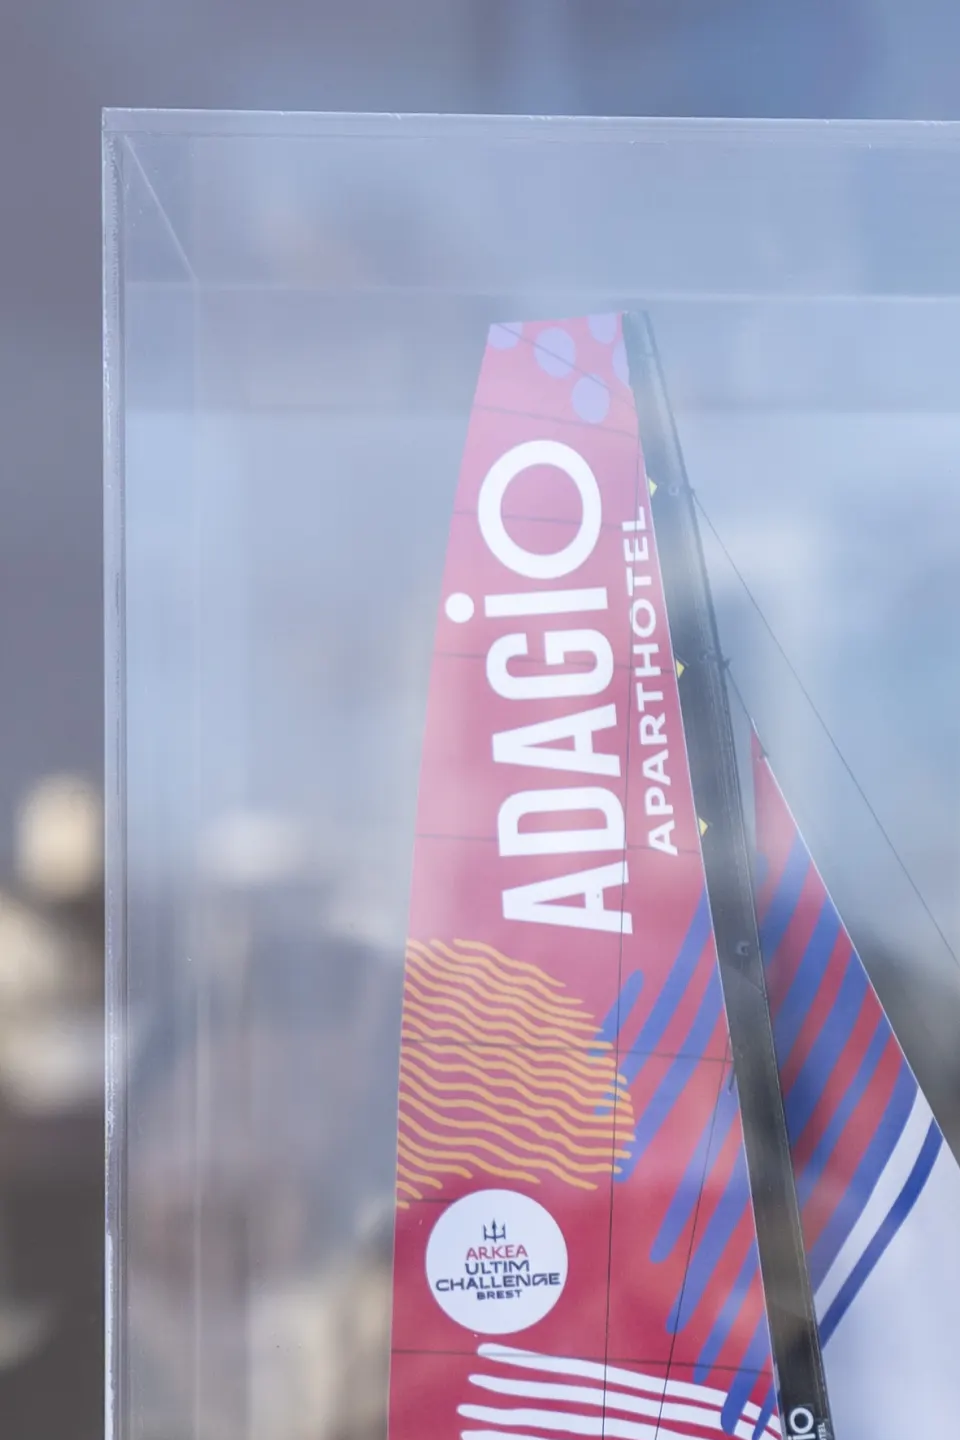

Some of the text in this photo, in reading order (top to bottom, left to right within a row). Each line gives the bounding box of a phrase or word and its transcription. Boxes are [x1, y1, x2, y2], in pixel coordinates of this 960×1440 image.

[622, 506, 678, 857] APARTHOTEL
[465, 1244, 529, 1260] ARKEA
[465, 1259, 530, 1275] ULTIM
[435, 1272, 561, 1292] CHALLENGE
[476, 1289, 523, 1301] BREST
